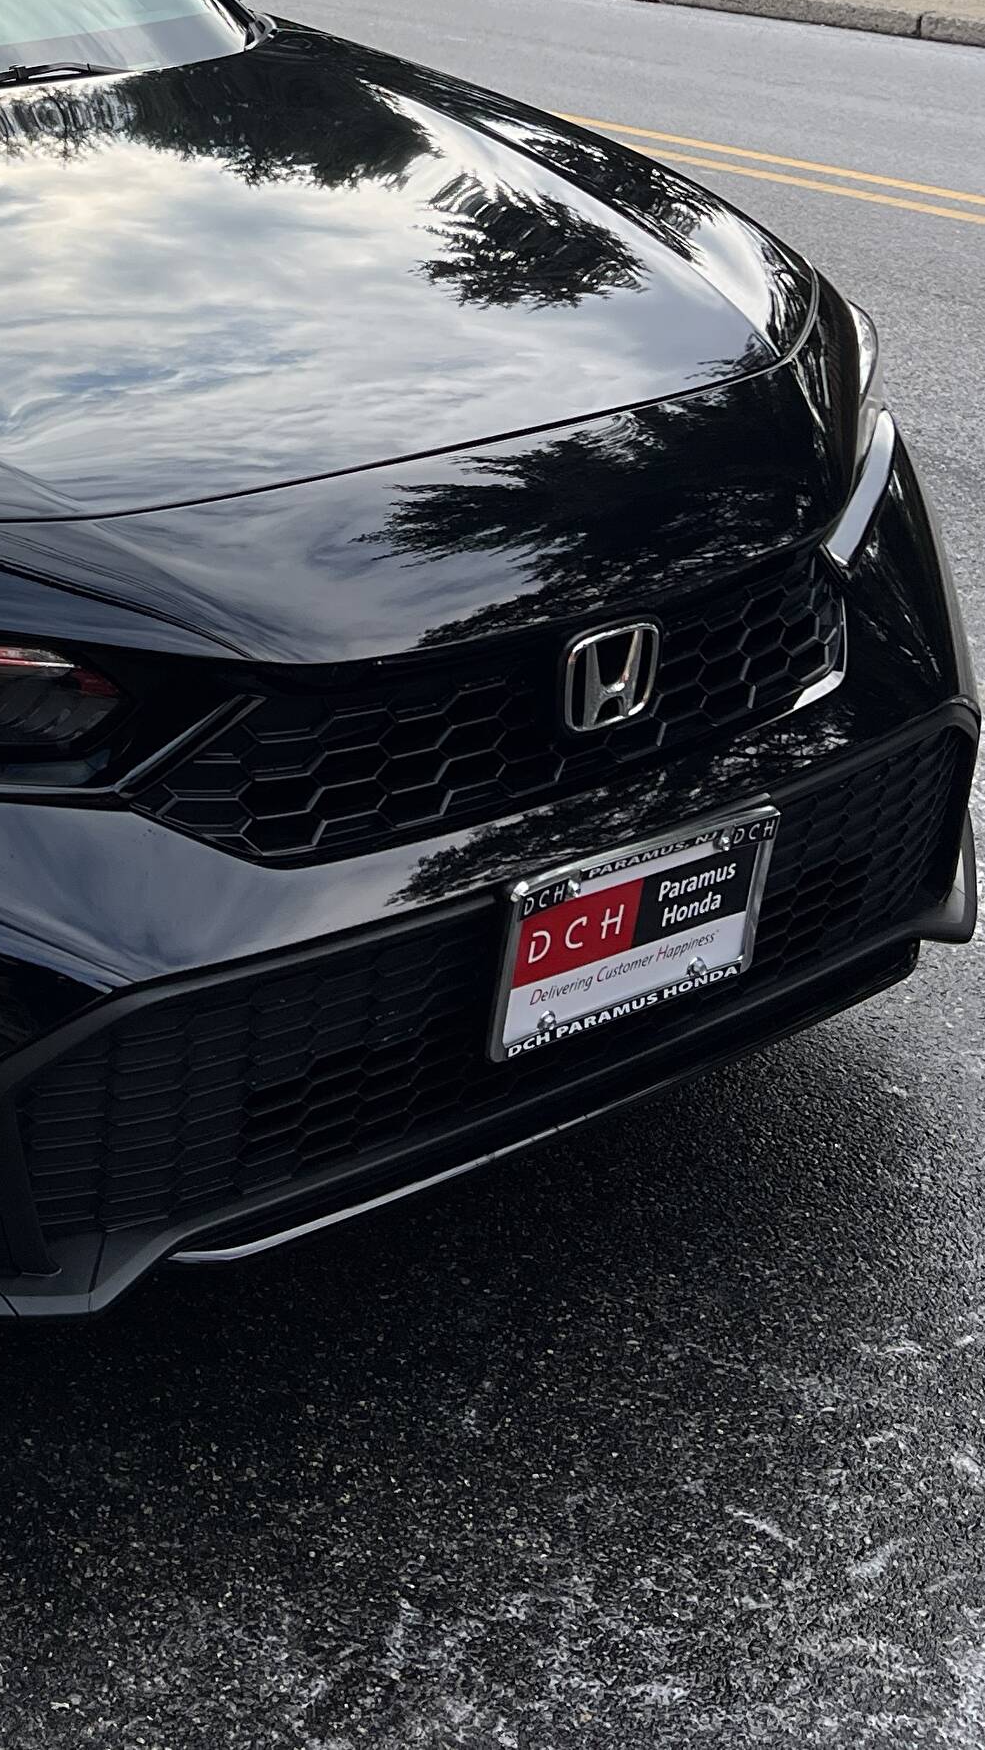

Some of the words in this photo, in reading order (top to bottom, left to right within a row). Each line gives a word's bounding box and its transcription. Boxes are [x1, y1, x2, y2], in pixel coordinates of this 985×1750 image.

[588, 841, 689, 878] PARAMUS,
[695, 832, 717, 845] NJ
[658, 862, 736, 902] Paramus
[661, 892, 722, 928] Honda
[529, 974, 593, 1006] Delivering
[596, 954, 655, 984] Customer
[655, 931, 716, 963] Happiness
[507, 1032, 551, 1058] DCH
[556, 992, 659, 1039] PARAMUS
[663, 965, 738, 999] HONDA
